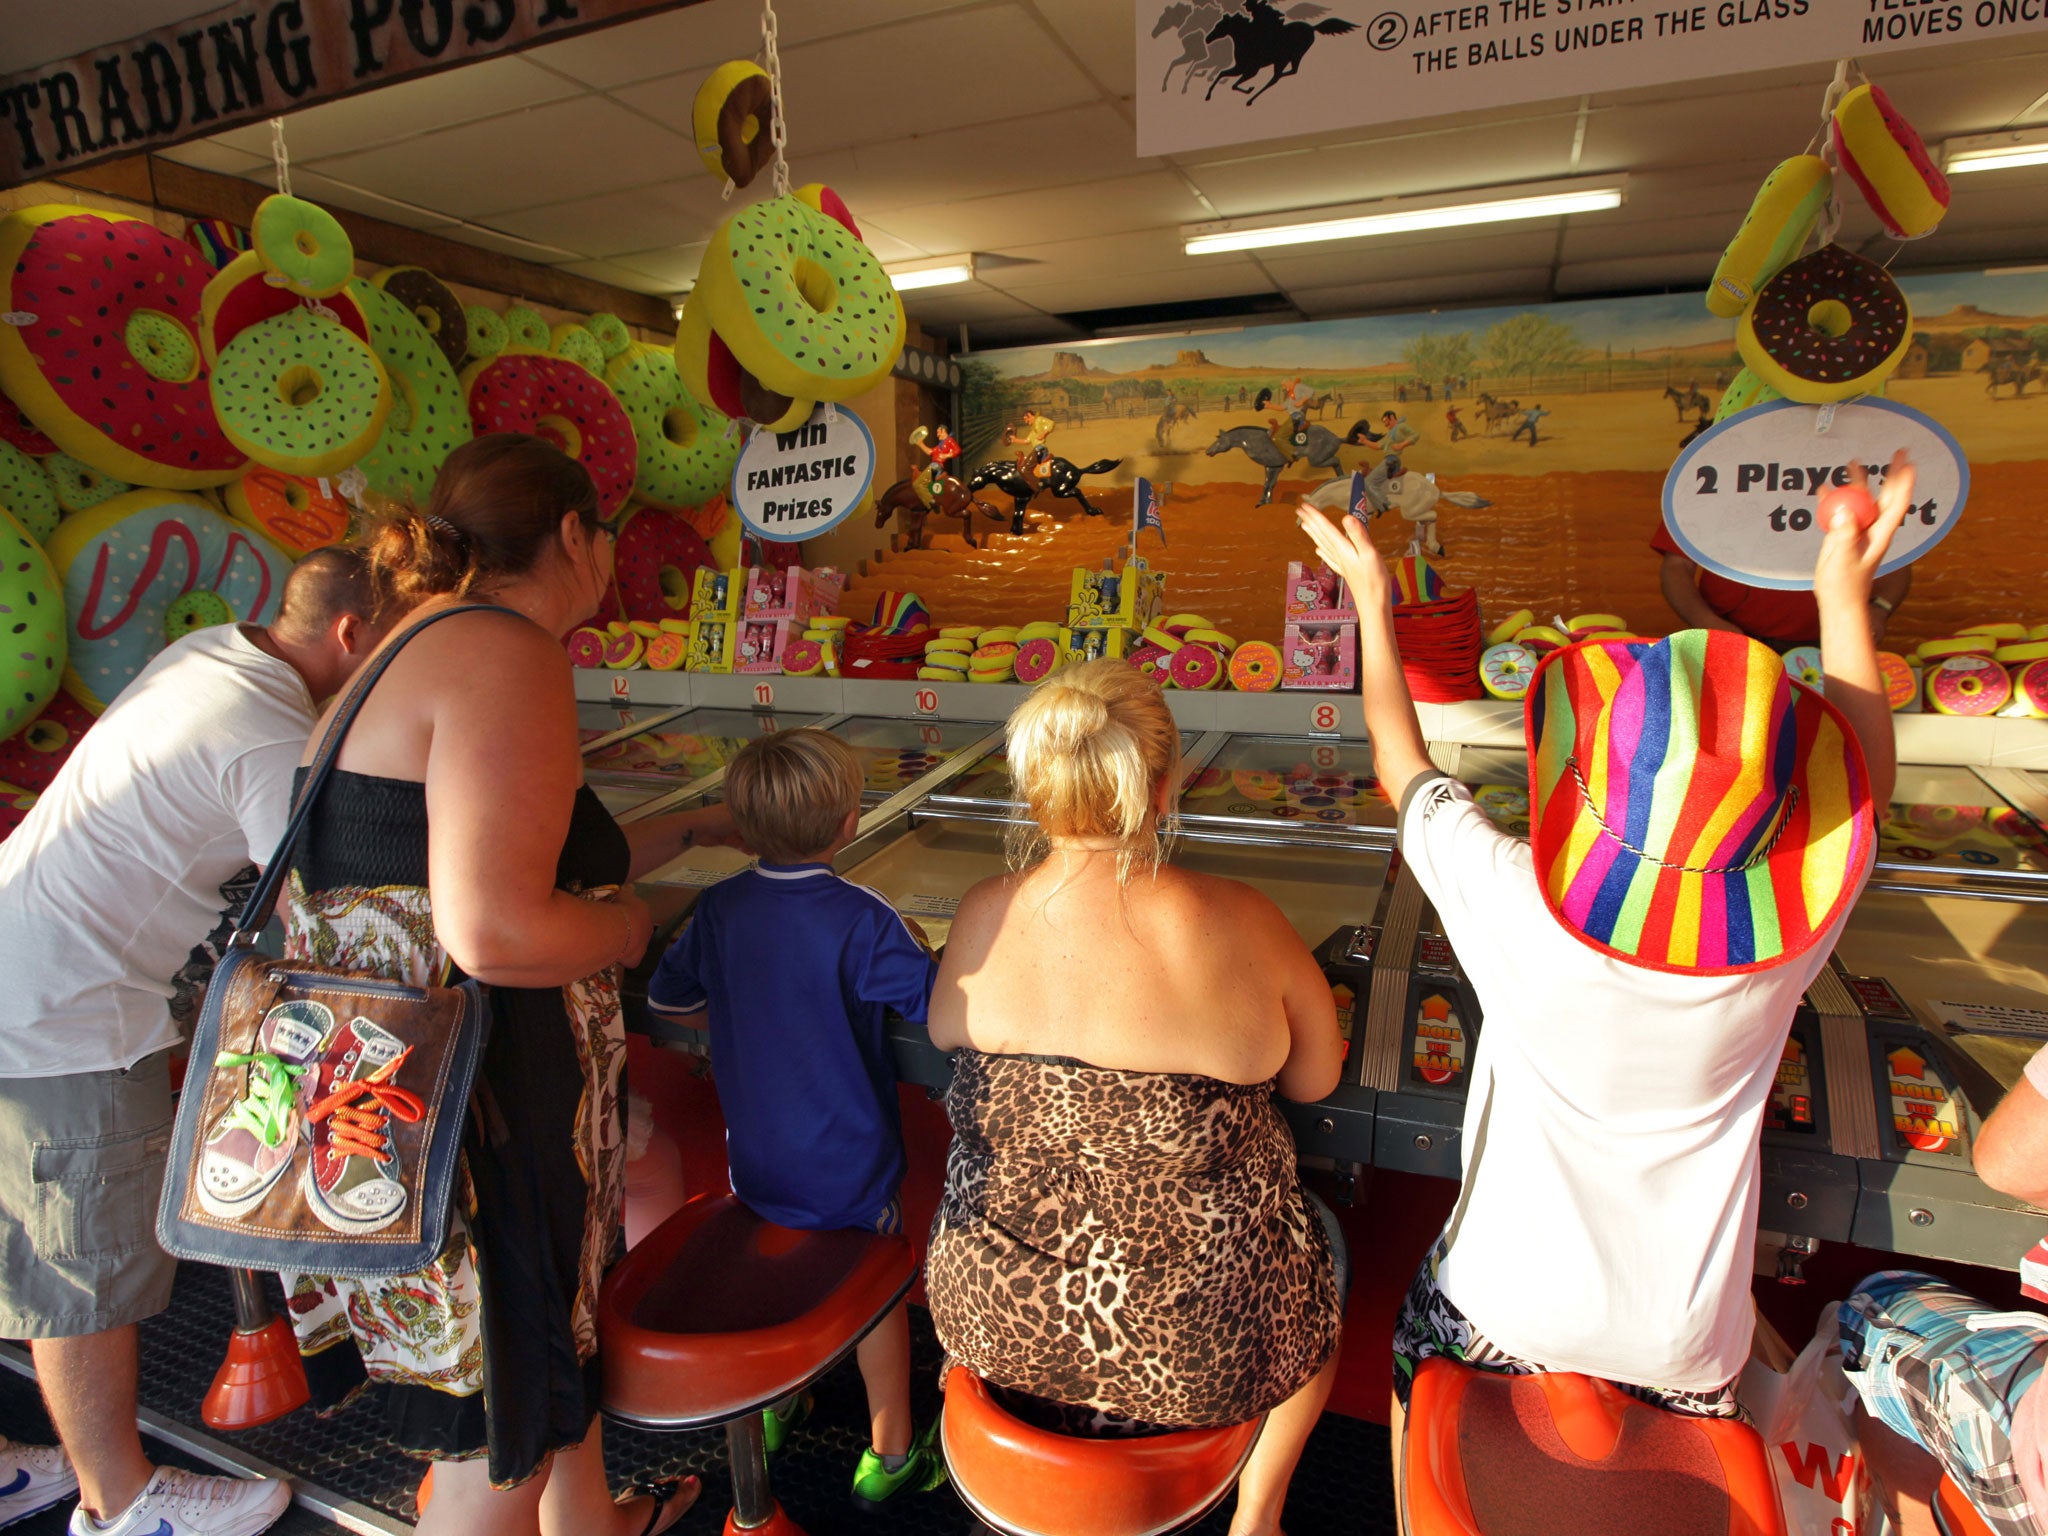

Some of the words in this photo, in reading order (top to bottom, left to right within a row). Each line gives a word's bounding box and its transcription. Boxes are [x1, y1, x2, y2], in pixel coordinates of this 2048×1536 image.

[1413, 5, 1488, 38] AFTER
[1500, 0, 1547, 23] THE
[1862, 5, 1963, 43] MOVES
[1975, 0, 2048, 27] ONC
[1412, 47, 1458, 74] THE
[1468, 32, 1544, 66] BALLS
[1555, 16, 1643, 53] UNDER
[1655, 7, 1707, 36] THE
[1717, 0, 1809, 27] GLASS
[0, 1, 317, 169] TRADING
[351, 0, 578, 78] PO
[747, 455, 857, 491] FANTASTIC
[1696, 465, 1718, 494] 2
[763, 498, 833, 524] Prizes
[1768, 503, 1812, 532] to
[755, 685, 770, 703] 11
[915, 691, 938, 711] 10
[1316, 705, 1335, 728] 8
[1903, 1101, 1937, 1116] THE
[1894, 1114, 1958, 1140] BALL
